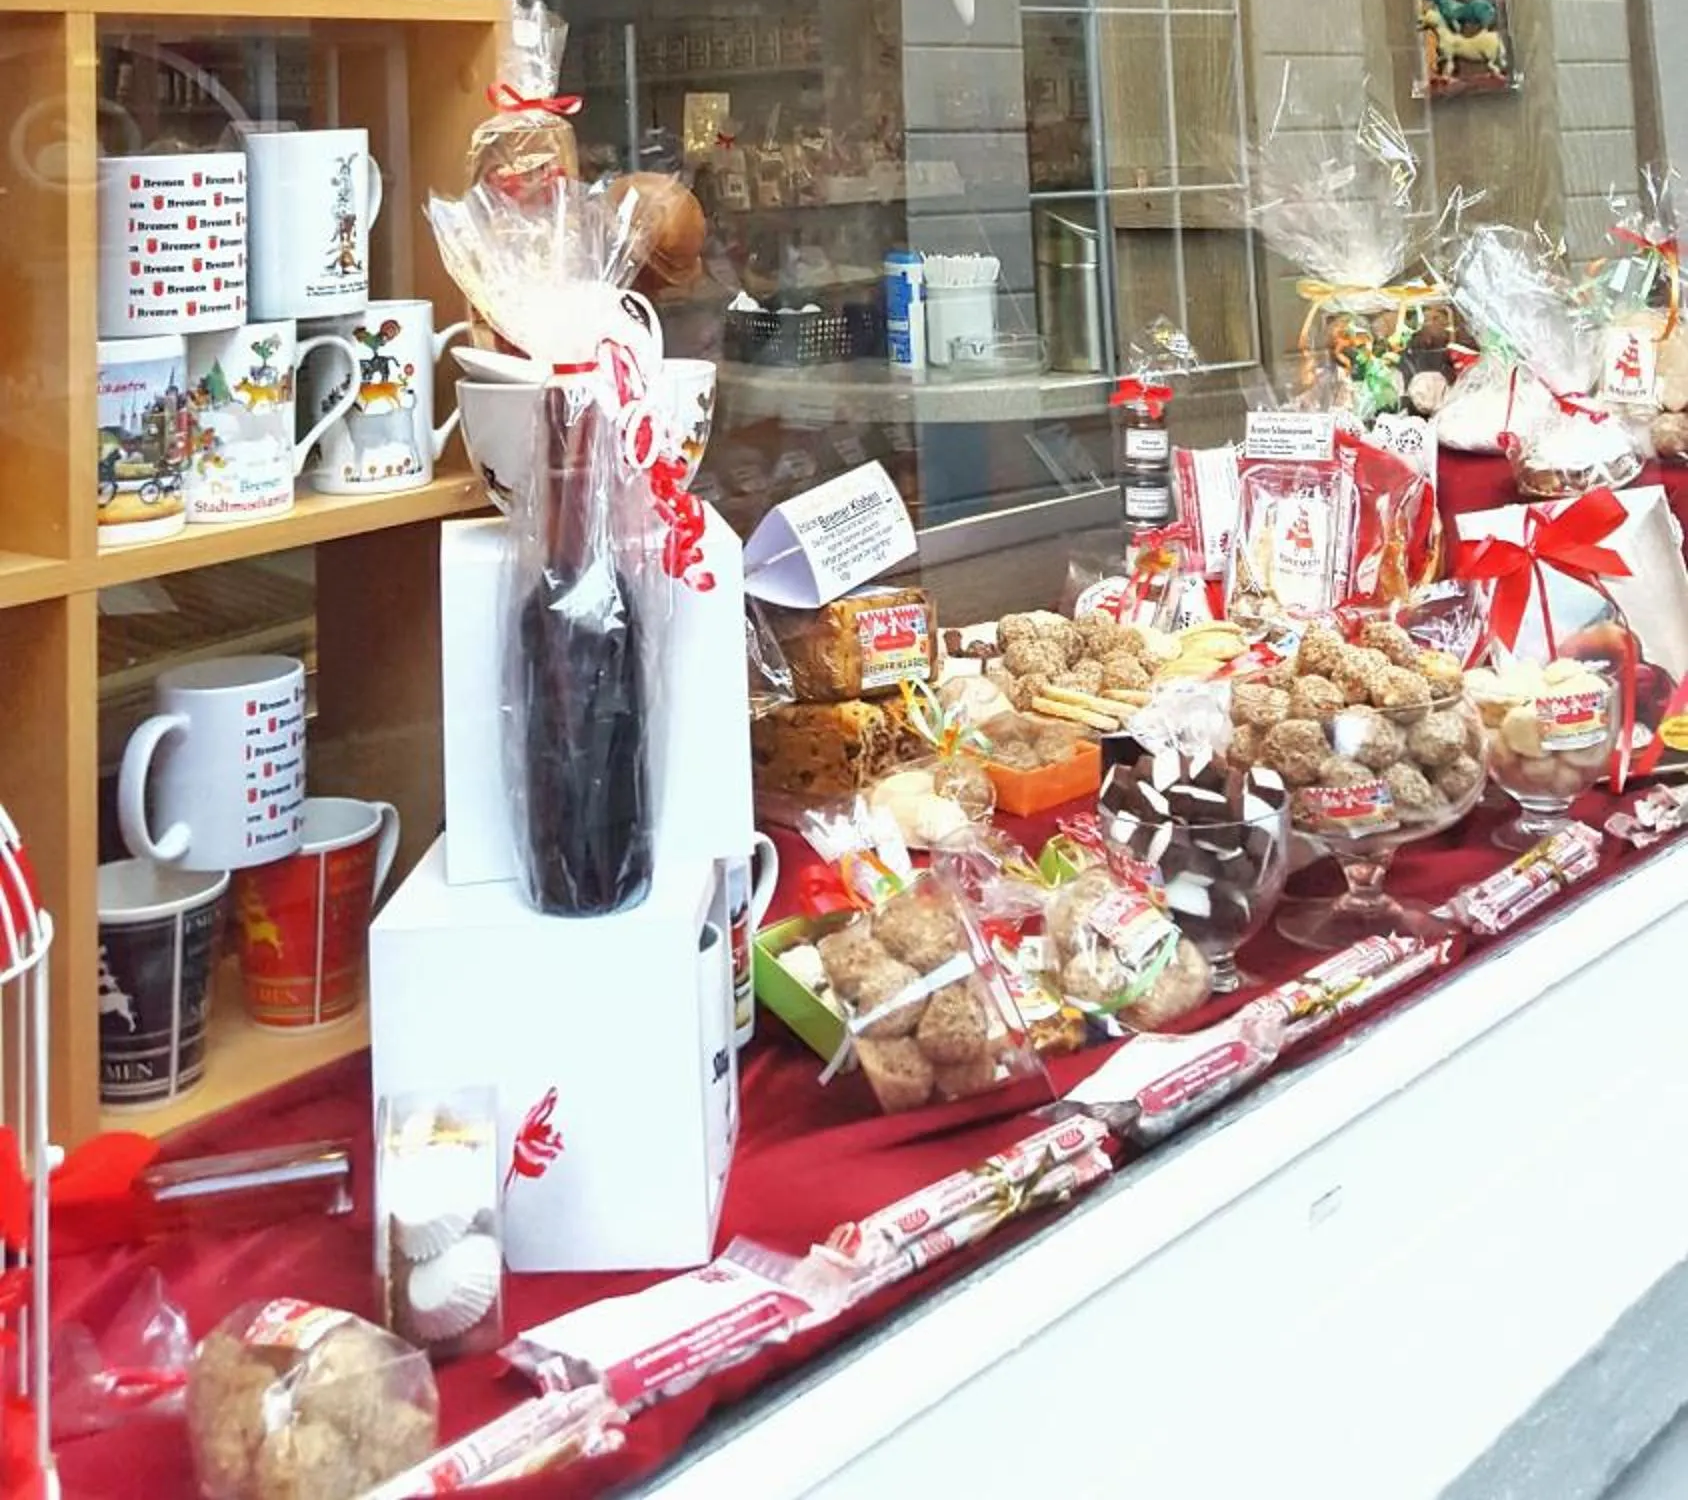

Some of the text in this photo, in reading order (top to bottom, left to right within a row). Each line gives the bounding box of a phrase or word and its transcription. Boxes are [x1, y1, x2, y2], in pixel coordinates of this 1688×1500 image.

[143, 178, 185, 189] Bremen
[167, 198, 207, 208] Bremen
[137, 221, 179, 232] Bremen
[161, 241, 201, 251] Bremen
[143, 264, 185, 274] Bremen
[167, 284, 207, 294] Bremen
[137, 307, 179, 318] Bremen
[104, 1061, 154, 1084] MEN
